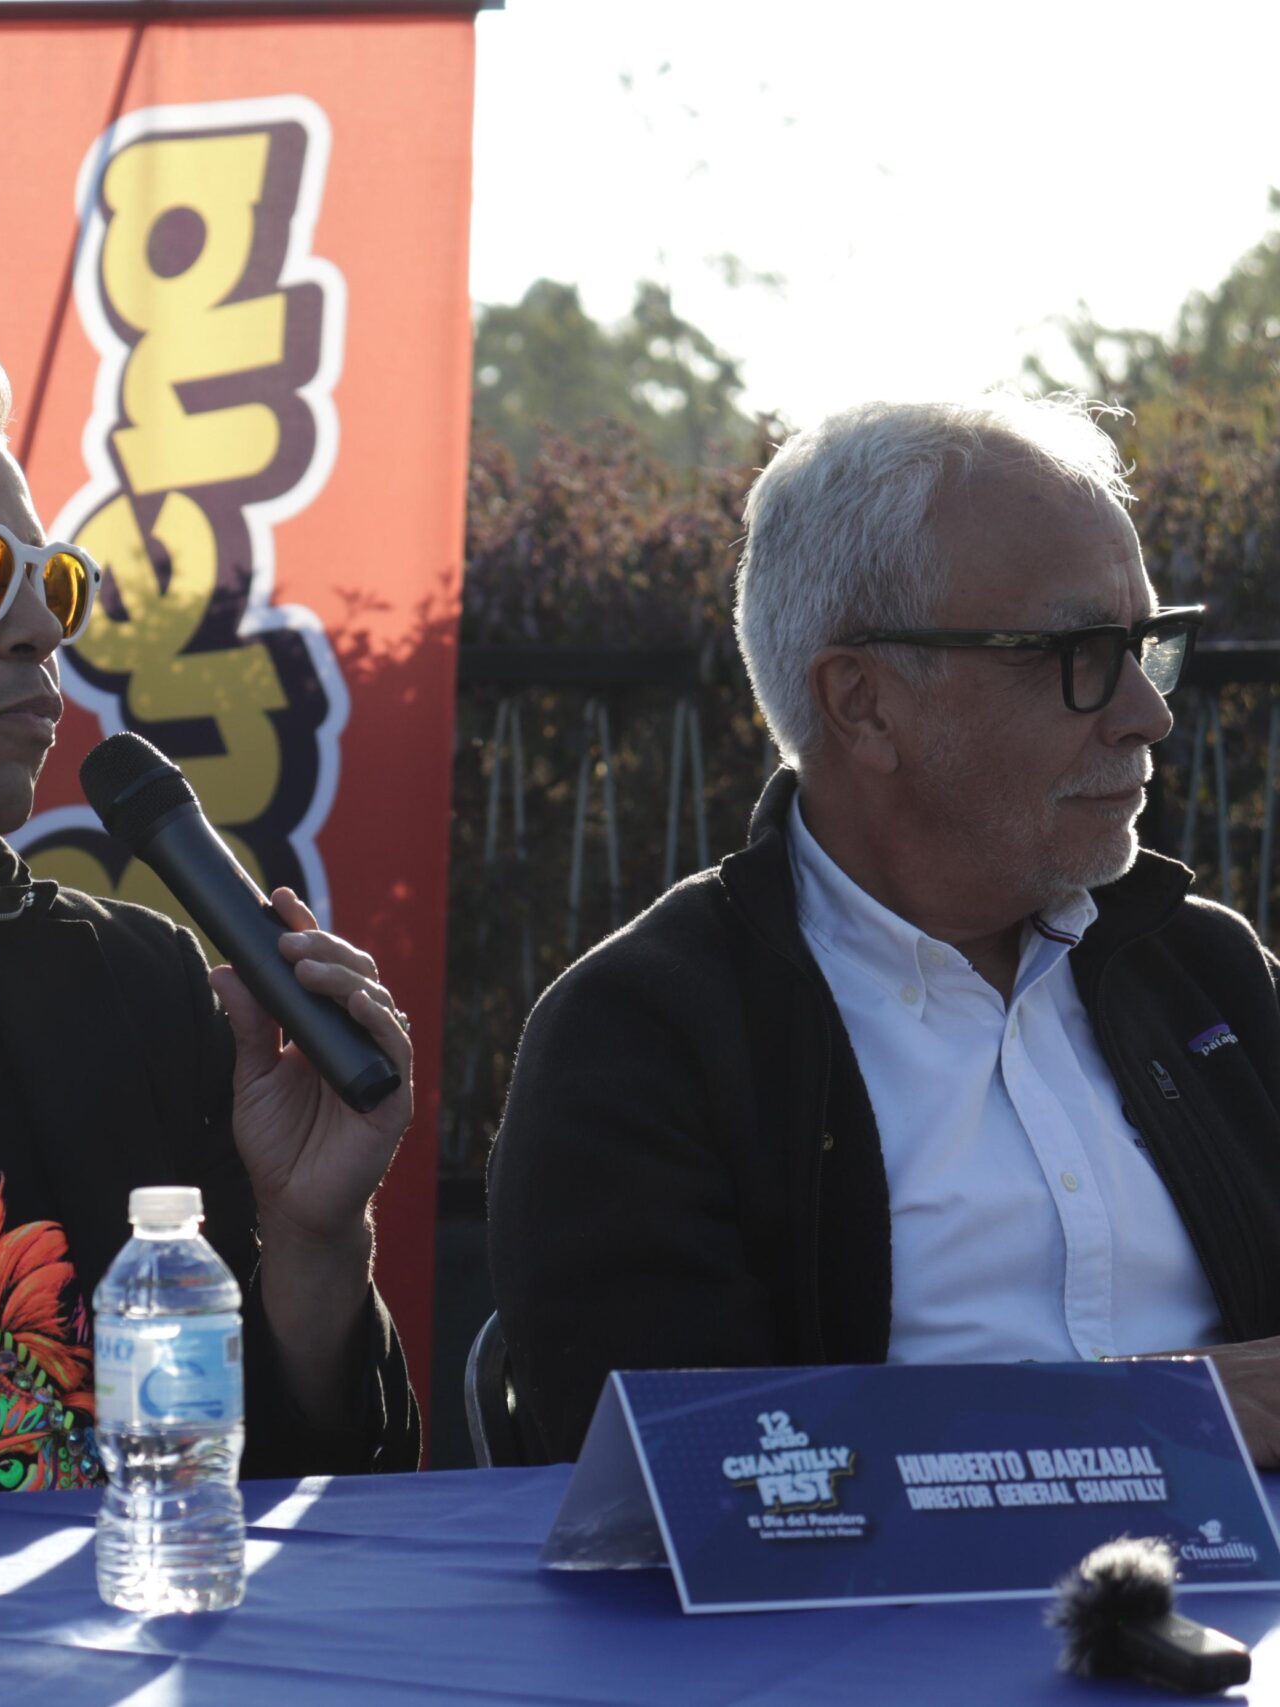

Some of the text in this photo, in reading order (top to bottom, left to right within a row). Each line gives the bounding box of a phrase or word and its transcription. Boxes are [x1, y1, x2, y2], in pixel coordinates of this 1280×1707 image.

[757, 1410, 795, 1436] 12
[722, 1446, 850, 1480] CHANTILLY
[895, 1446, 1163, 1485] HUMBERTO IBARZABAL
[756, 1470, 832, 1506] FEST
[906, 1477, 1167, 1511] DIRECTOR GENERAL CHANTILLY
[1180, 1542, 1258, 1563] Chantilly
